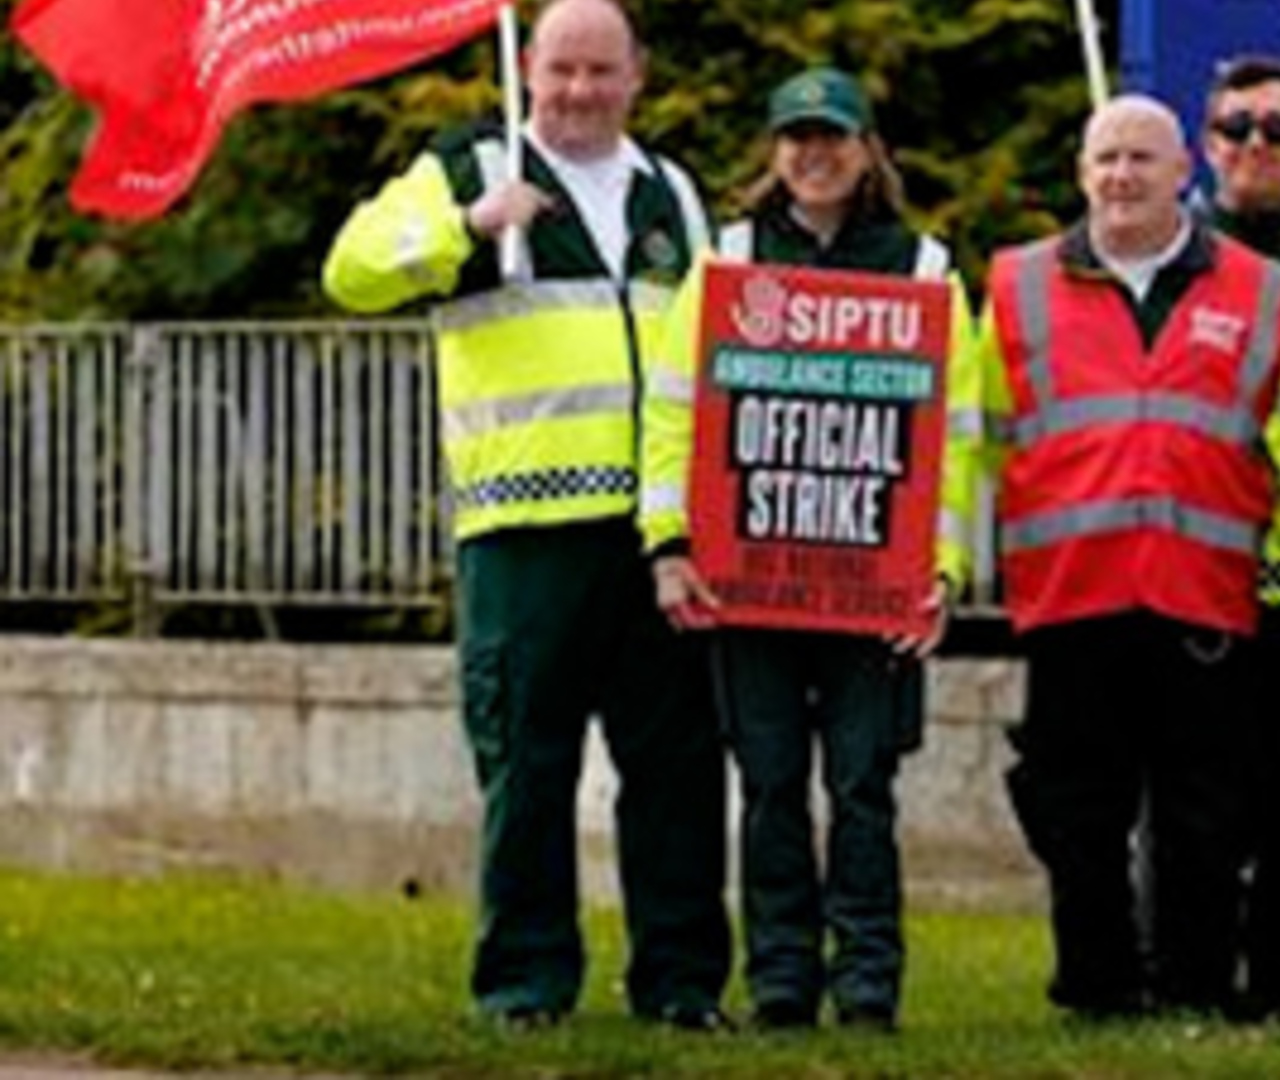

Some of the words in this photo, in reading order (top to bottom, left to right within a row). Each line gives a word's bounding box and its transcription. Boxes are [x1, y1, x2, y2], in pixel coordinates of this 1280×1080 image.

[785, 292, 922, 349] SIPTU
[713, 350, 849, 393] AMBULANCE
[852, 358, 934, 399] SECTOR
[736, 396, 904, 476] OFFICIAL
[746, 468, 886, 546] STRIKE
